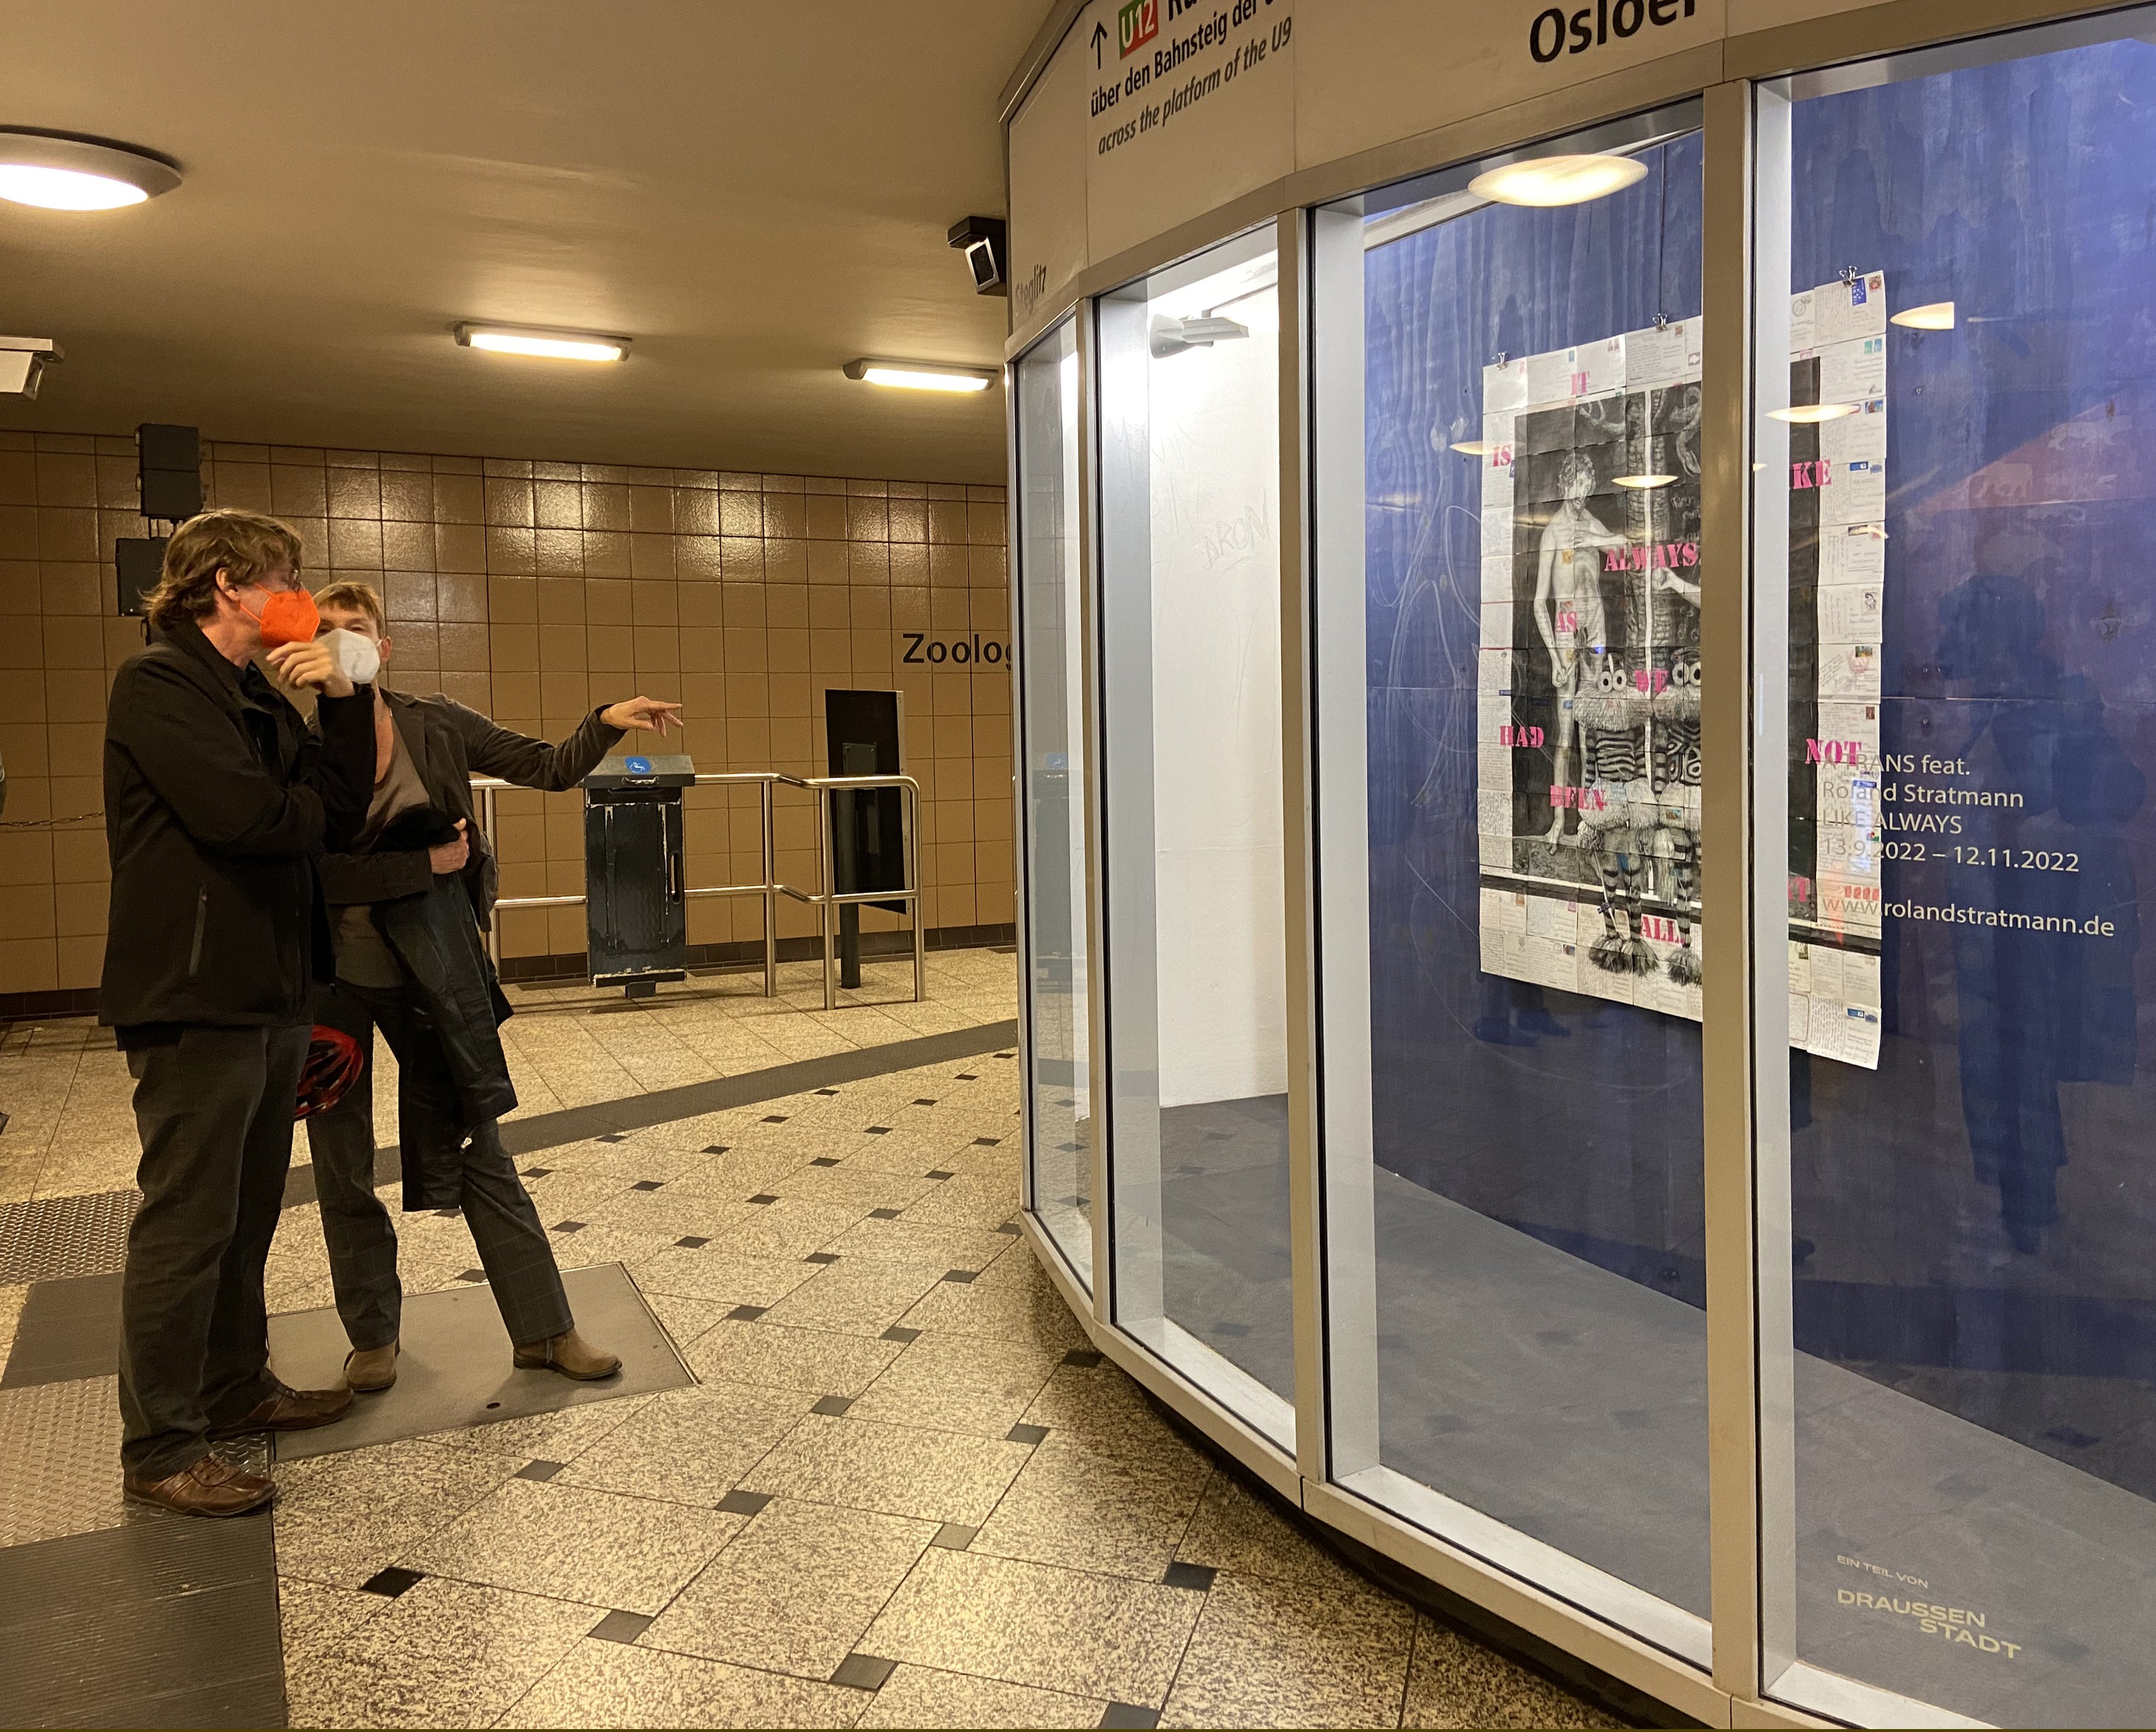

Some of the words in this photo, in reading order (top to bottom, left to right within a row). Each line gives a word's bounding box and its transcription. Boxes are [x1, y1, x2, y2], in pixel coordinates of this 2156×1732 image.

[1121, 0, 1154, 49] U12
[1091, 82, 1121, 117] über
[1125, 64, 1150, 97] den
[1154, 11, 1227, 79] Bahnsteig
[1098, 119, 1136, 155] across
[1140, 105, 1160, 134] the
[1162, 68, 1221, 127] platform
[1224, 46, 1242, 82] of
[1243, 38, 1267, 71] the
[1272, 16, 1292, 53] U9
[1571, 371, 1590, 396] IT
[1492, 444, 1512, 467] IS
[1604, 542, 1699, 572] ALWAYS
[1555, 612, 1577, 632] AS
[1635, 670, 1668, 693] WE
[1499, 726, 1544, 748] HAD
[1805, 738, 1862, 767] NOT
[1921, 756, 1970, 776] feat.
[1550, 785, 1608, 811] BEEN
[1823, 780, 1897, 802] Roland
[1903, 784, 2024, 808] Stratmann
[1823, 810, 1866, 828] LIKE
[1875, 812, 1962, 834] ALWAYS
[1825, 838, 1926, 862] 13.9.2022
[1954, 846, 2080, 872] 12.11.2022
[1637, 916, 1685, 946] ALL
[1822, 898, 2115, 937] www.rolandstratmann.de
[1837, 1555, 1860, 1568] EIN
[1862, 1563, 1893, 1579] TEIL
[1896, 1572, 1928, 1589] VON
[1837, 1589, 1985, 1629] DRAUSSEN
[1920, 1619, 2022, 1659] STADT
